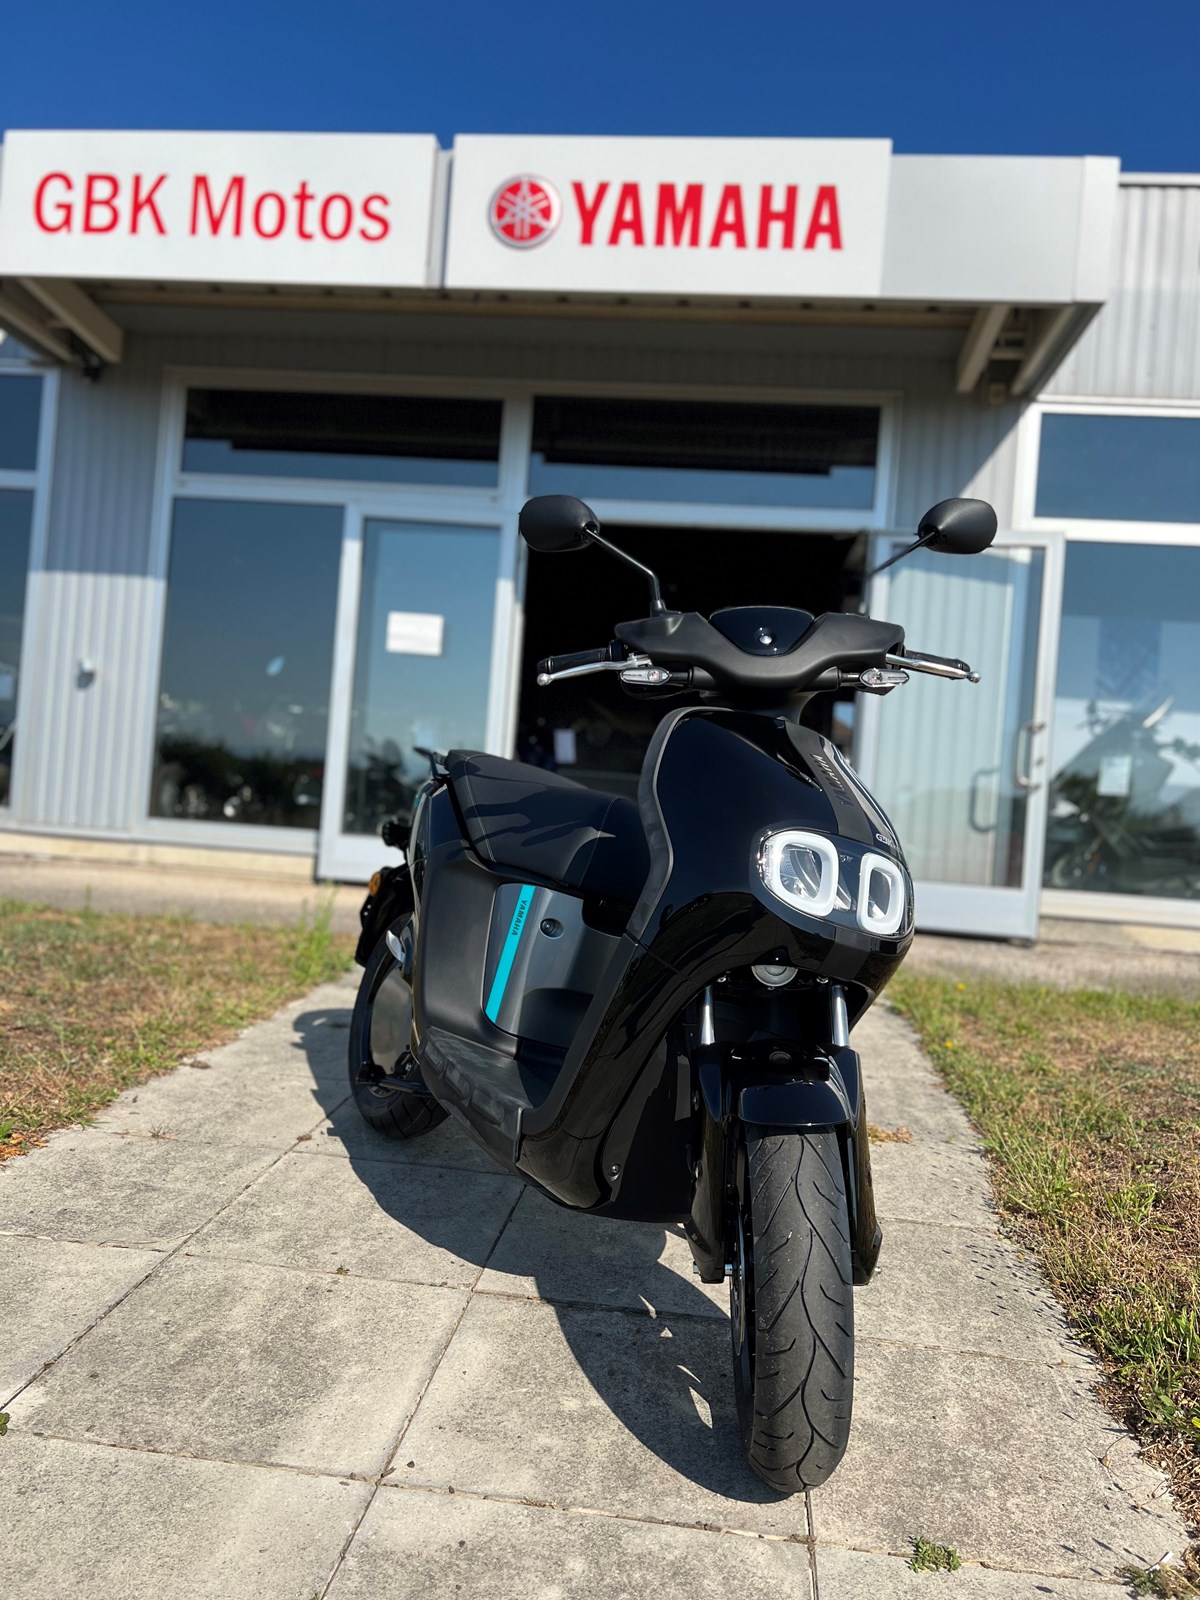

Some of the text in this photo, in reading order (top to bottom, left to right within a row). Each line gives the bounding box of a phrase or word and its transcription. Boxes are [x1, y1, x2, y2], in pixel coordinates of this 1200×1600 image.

[34, 173, 391, 242] GBK Motos
[572, 181, 843, 251] YAMAHA
[511, 899, 528, 936] YAMAHA
